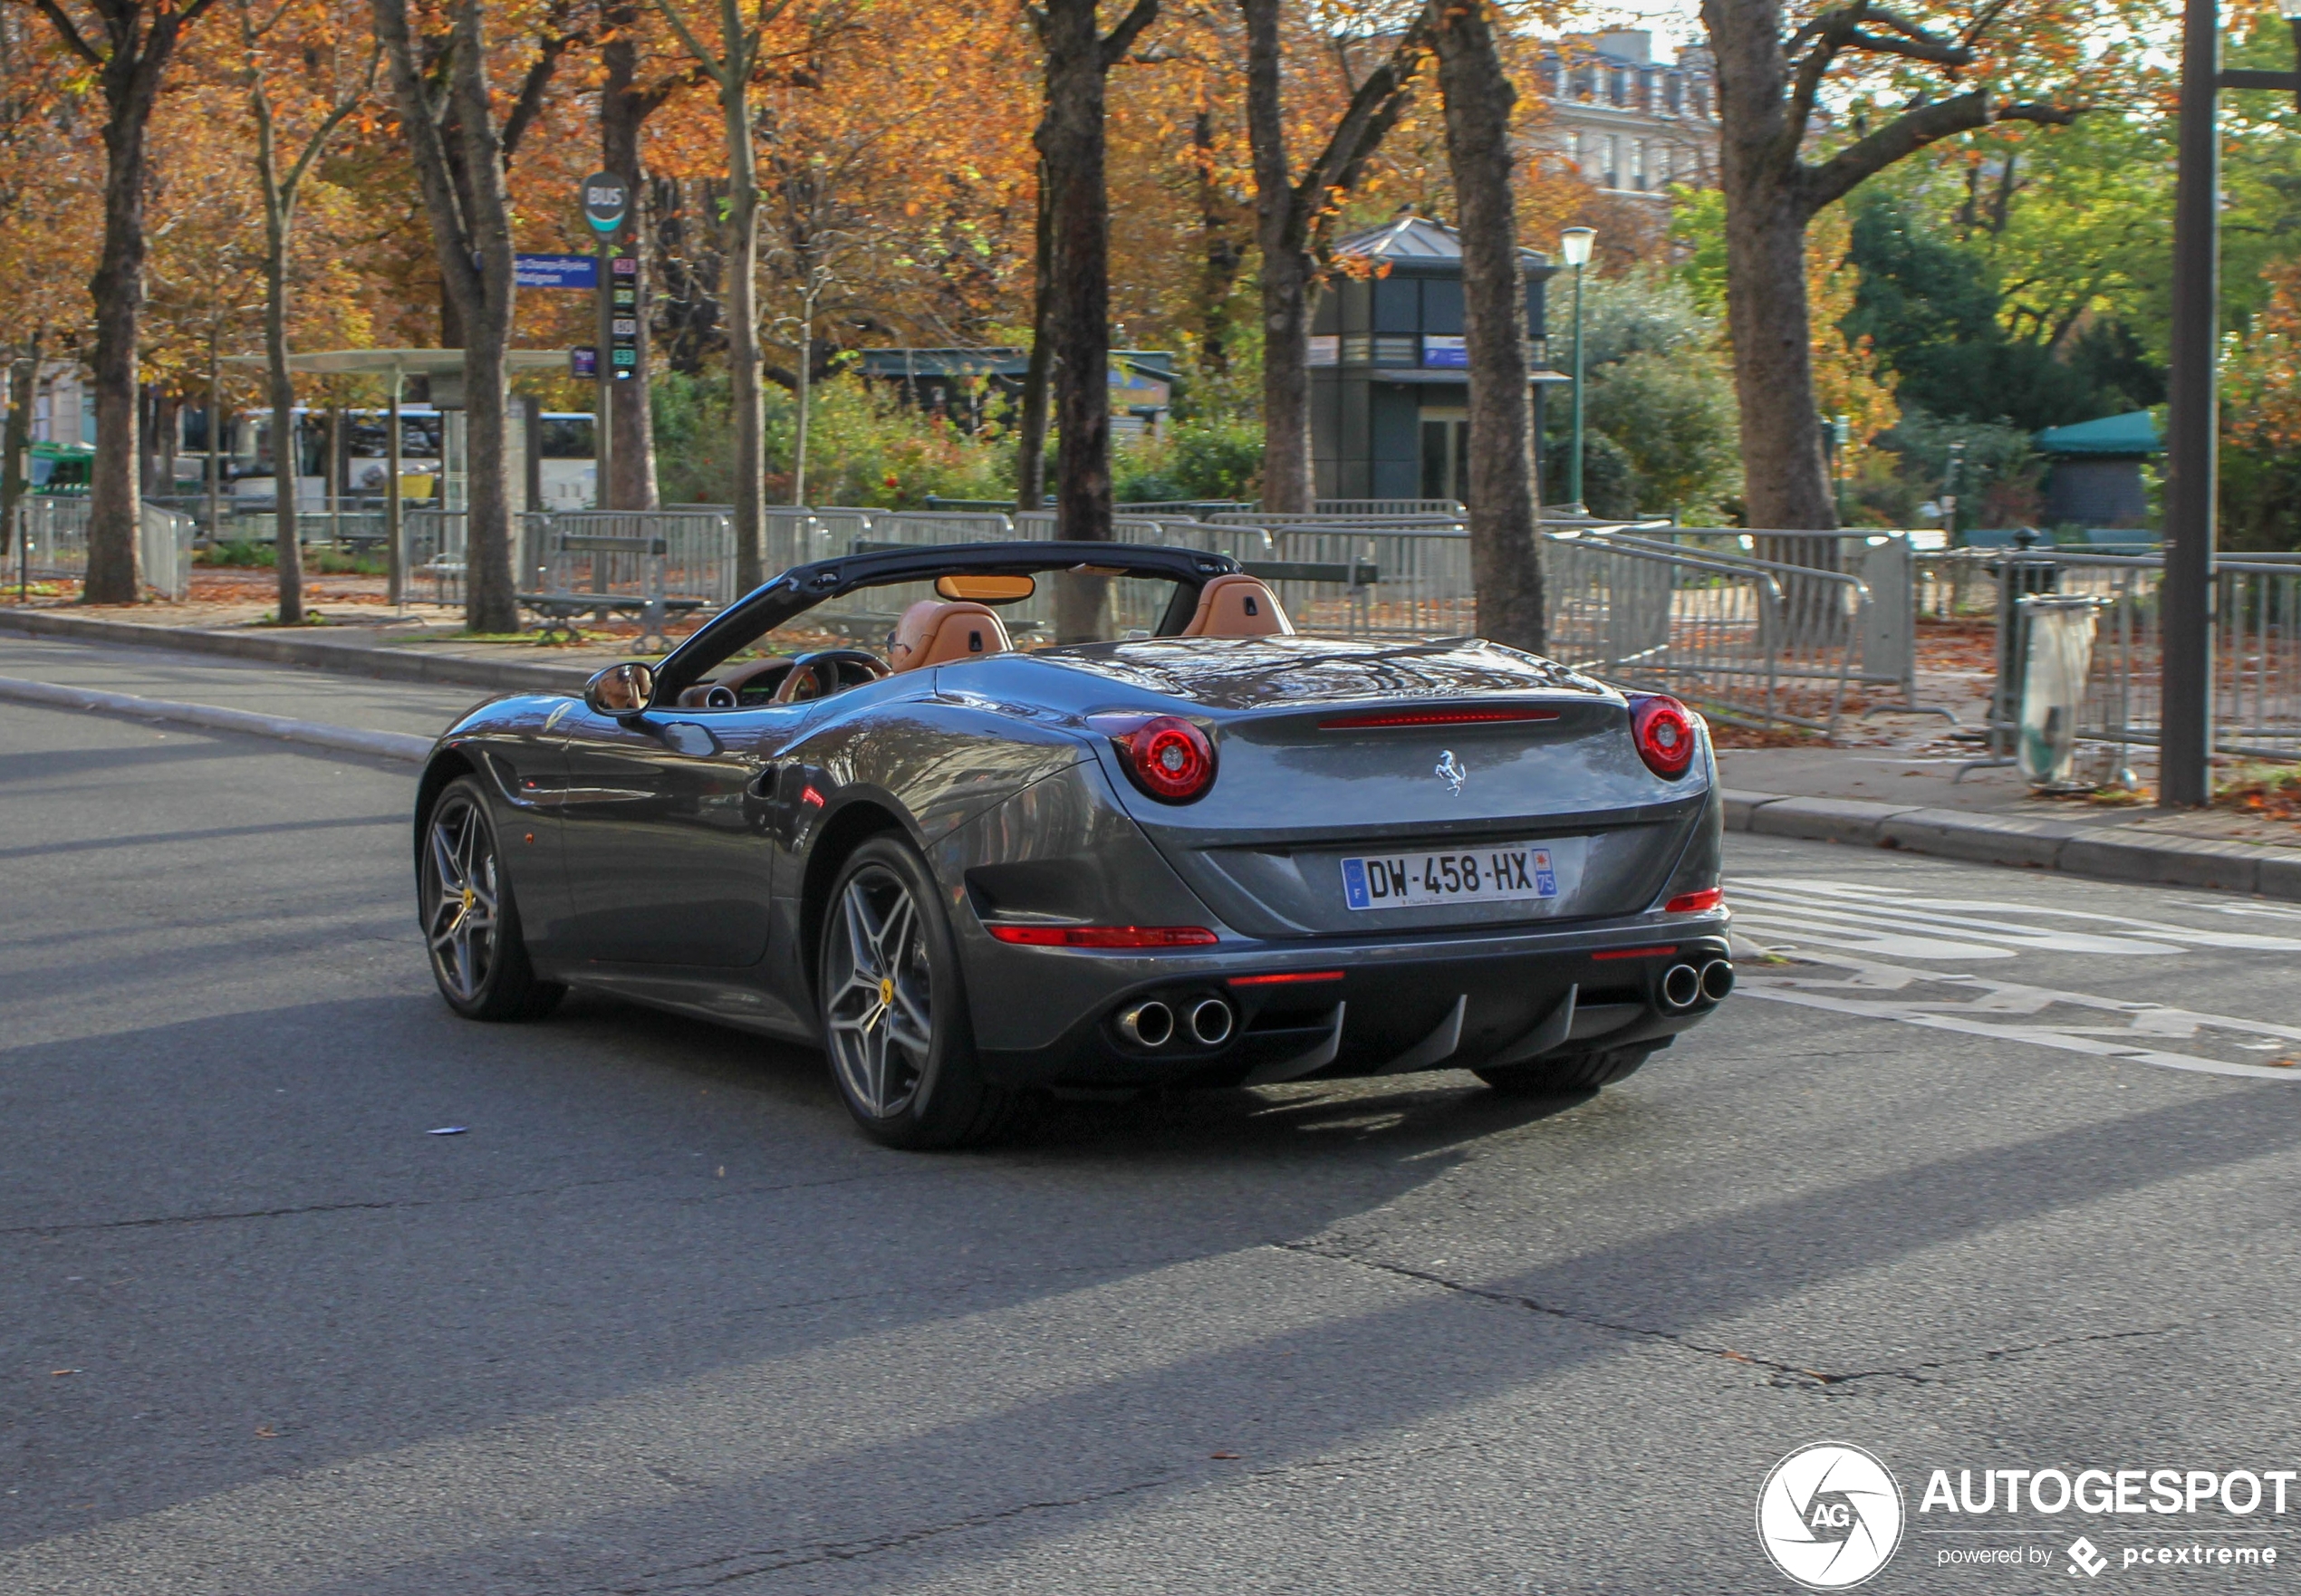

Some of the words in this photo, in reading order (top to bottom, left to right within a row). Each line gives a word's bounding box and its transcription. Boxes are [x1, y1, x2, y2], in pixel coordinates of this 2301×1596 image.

[588, 187, 622, 206] BUS
[1354, 889, 1361, 899] F
[1367, 852, 1533, 899] DW-458-HX
[1537, 874, 1555, 892] 75
